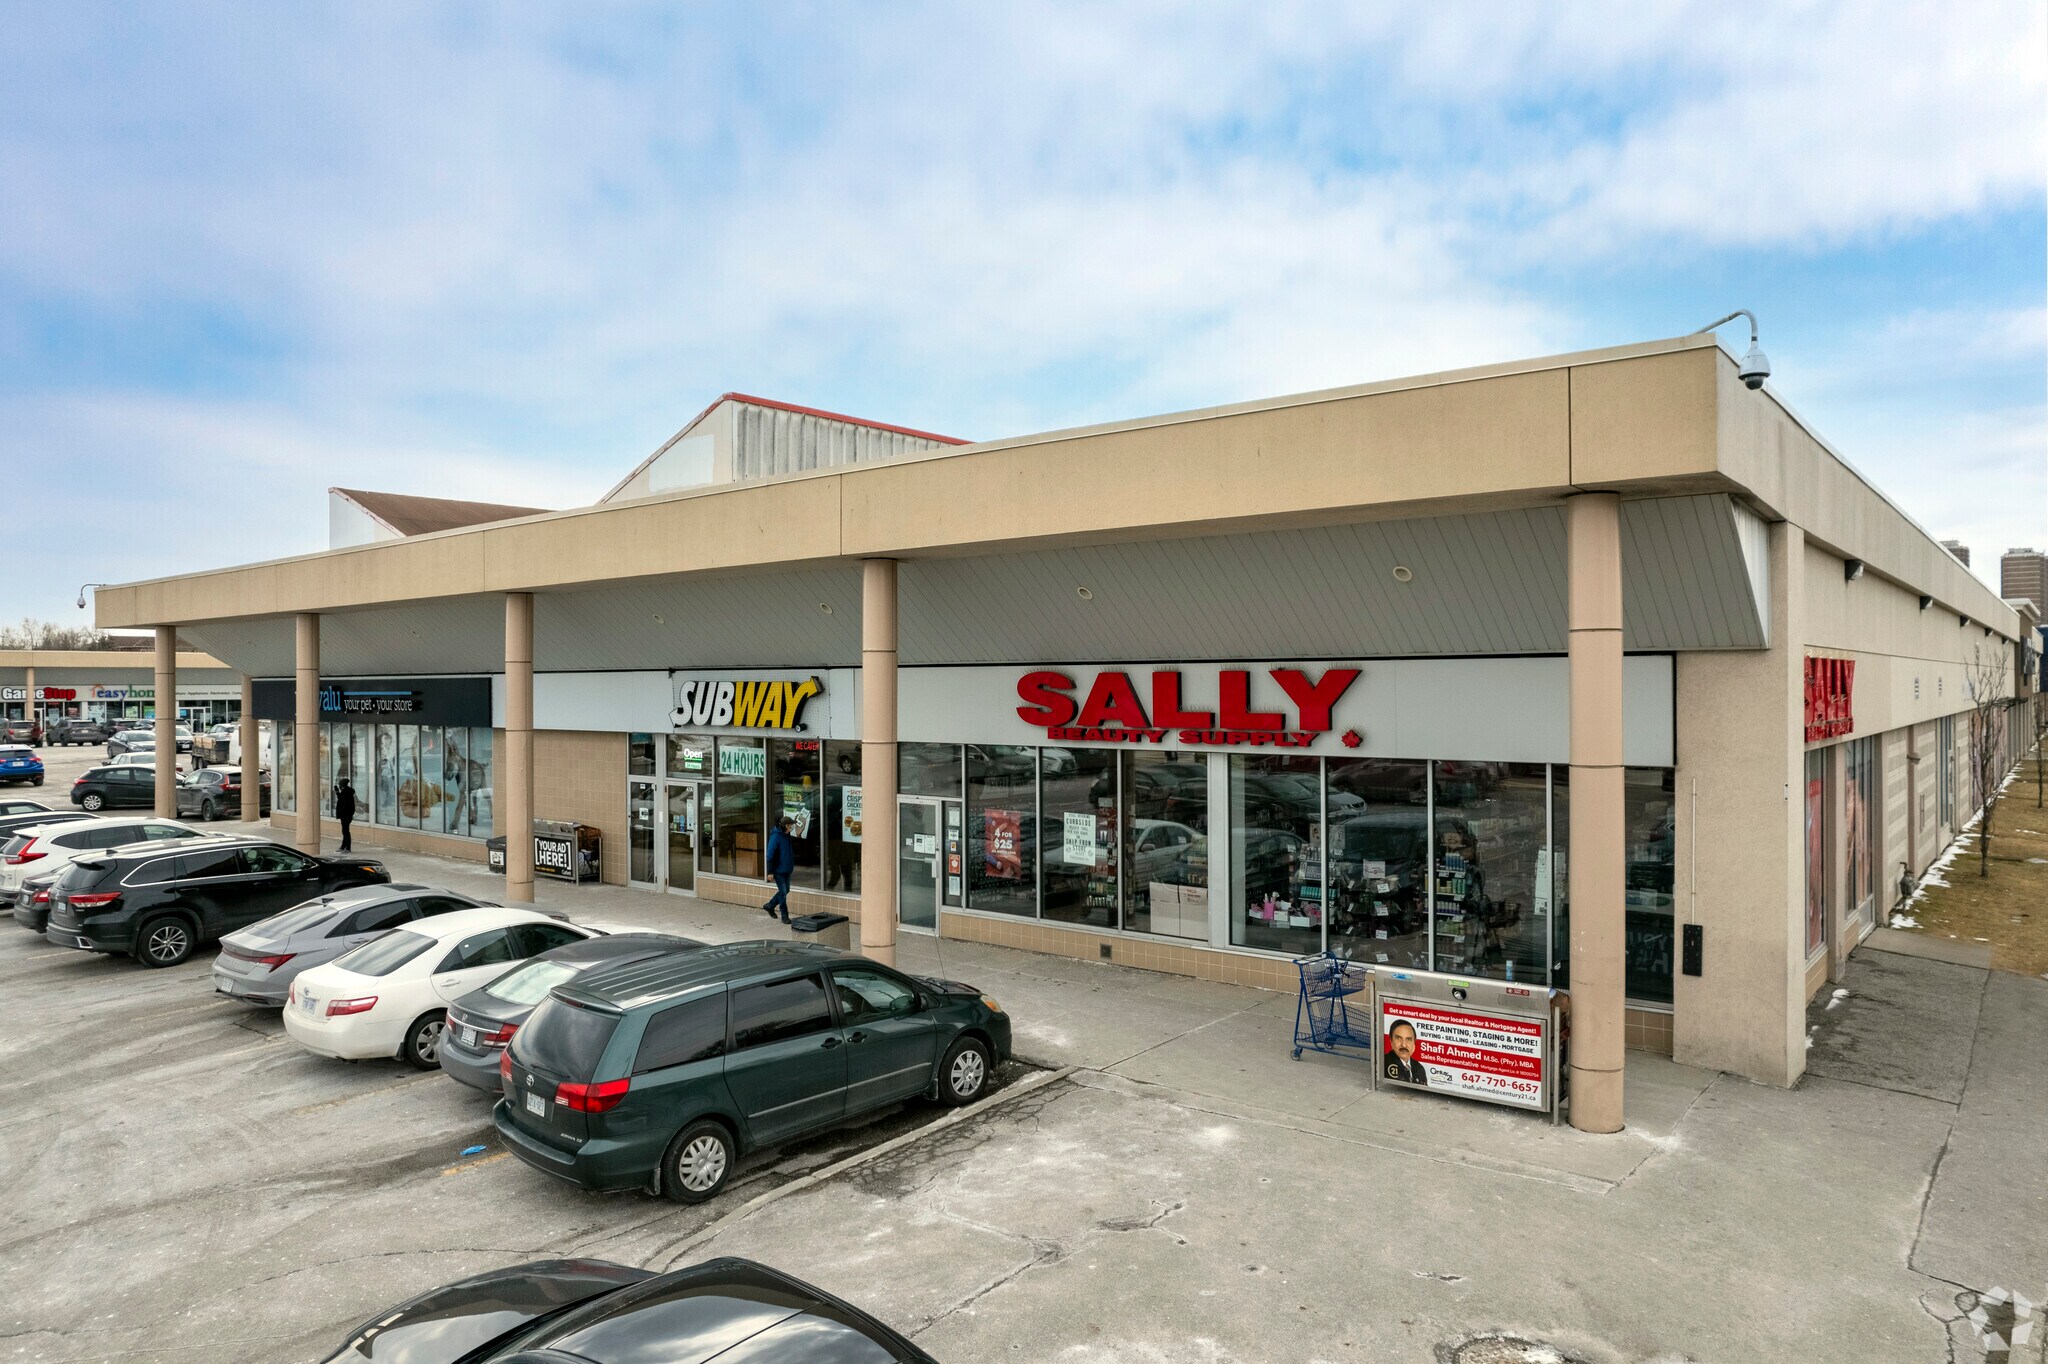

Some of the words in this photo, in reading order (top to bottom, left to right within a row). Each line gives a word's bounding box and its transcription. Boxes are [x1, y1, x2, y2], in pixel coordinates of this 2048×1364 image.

[344, 699, 359, 714] your
[360, 699, 372, 714] pet
[376, 699, 392, 714] your
[394, 699, 412, 711] store
[669, 676, 820, 729] SUBWAY
[1016, 669, 1362, 731] SALLY
[1047, 727, 1169, 743] BEAUTY
[1179, 730, 1320, 747] SUPPLY
[684, 749, 703, 758] Open
[721, 751, 731, 773] 24
[734, 752, 764, 776] HOURS
[1066, 818, 1091, 826] CURBSIDE
[994, 828, 1000, 838] 4
[539, 840, 557, 852] YOUR
[557, 843, 566, 853] AD
[994, 838, 1013, 849] $25
[539, 850, 567, 868] HERE!
[1431, 1013, 1438, 1021] by
[1450, 1016, 1463, 1024] local
[1464, 1018, 1484, 1027] Realtor
[1490, 1022, 1516, 1032] Mortgage
[1517, 1026, 1537, 1035] Agent!
[1416, 1022, 1434, 1031] FREE
[1435, 1025, 1472, 1037] PAINTING,
[1473, 1030, 1505, 1042] STAGING
[1506, 1035, 1512, 1043] &
[1514, 1037, 1538, 1047] MORE!
[1420, 1032, 1441, 1040] BUYING
[1445, 1036, 1469, 1044] SELLING
[1473, 1040, 1498, 1049] LEASING
[1501, 1044, 1534, 1054] MORTGAGE
[1420, 1042, 1444, 1054] Shafi
[1447, 1046, 1482, 1060] Ahmed
[1519, 1060, 1535, 1069] MBA
[1420, 1053, 1436, 1061] Sales
[1436, 1055, 1479, 1068] Representative
[1461, 1072, 1539, 1094] 647-770-6657
[1461, 1083, 1536, 1101] shafi.ahmed@century21.ca
